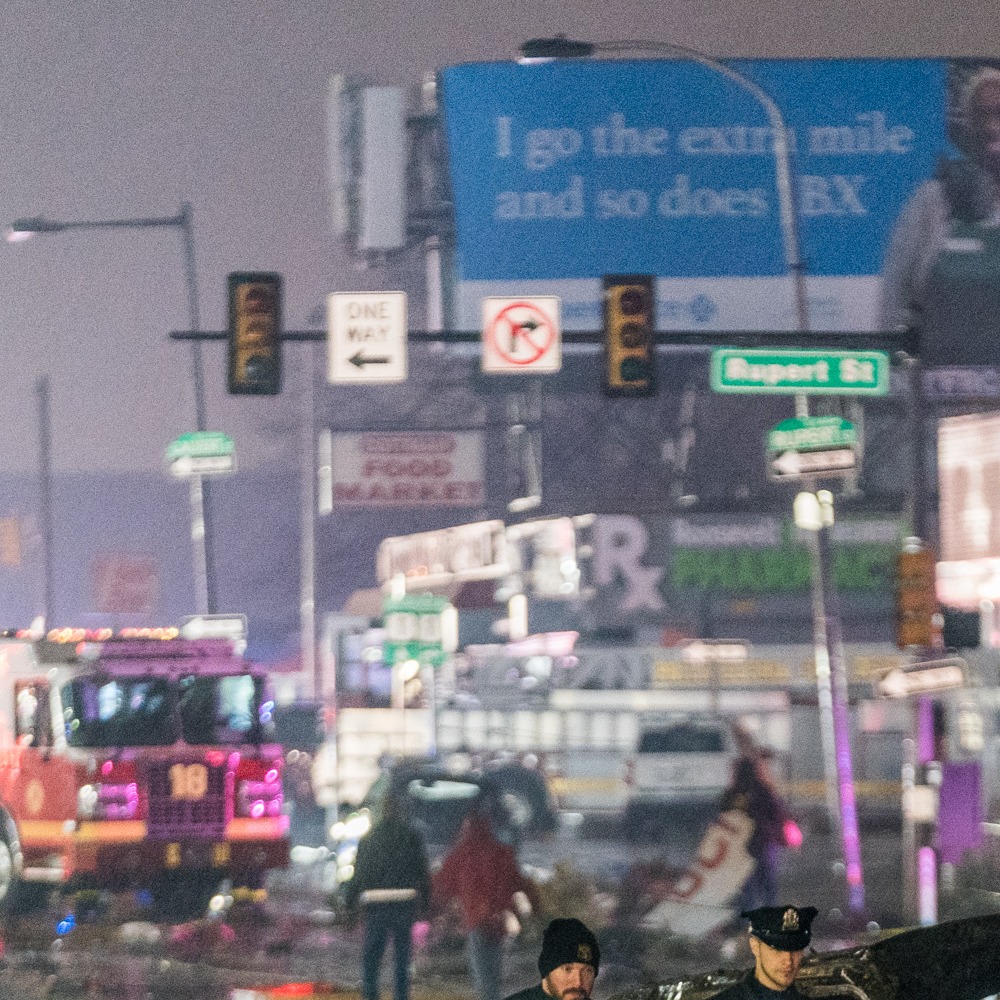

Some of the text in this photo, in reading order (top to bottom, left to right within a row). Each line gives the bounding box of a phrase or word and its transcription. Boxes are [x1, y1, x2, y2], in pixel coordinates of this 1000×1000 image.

[497, 115, 513, 157] I
[526, 128, 583, 171] go
[593, 112, 669, 156] the
[808, 110, 915, 154] mile
[496, 173, 869, 220] and so does BX
[348, 302, 389, 321] ONE
[347, 325, 390, 343] WAY
[725, 356, 874, 387] Rupert St
[362, 458, 453, 478] FOOD
[333, 481, 483, 501] MARKET
